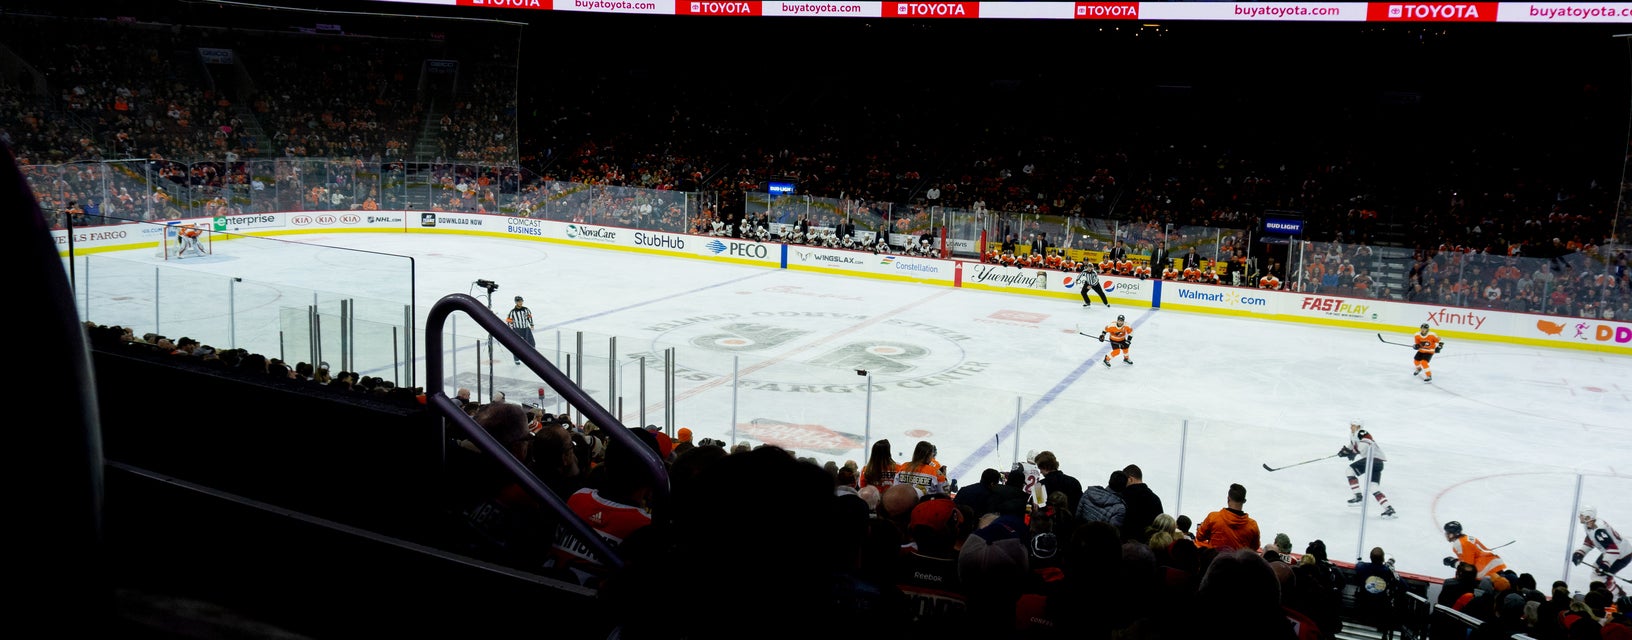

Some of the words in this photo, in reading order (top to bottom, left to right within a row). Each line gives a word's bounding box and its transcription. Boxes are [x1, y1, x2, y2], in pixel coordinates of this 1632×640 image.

[575, 0, 655, 10] buyatoyota.com
[702, 2, 750, 13] TOYOTA
[782, 2, 861, 13] buyatoyota.com
[910, 4, 965, 15] TOYOTA
[1088, 5, 1137, 15] TOYOTA
[1234, 5, 1340, 17] buyatoyota.com
[1404, 5, 1479, 18] TOYOTA
[1530, 5, 1632, 19] buyatoyota.c
[218, 214, 275, 226] enterprise
[438, 217, 469, 226] DOWNLOAD
[470, 218, 483, 226] NOW
[508, 217, 542, 227] COMCAST
[508, 225, 542, 236] BUSINESS
[579, 226, 616, 240] NovaCare
[1280, 223, 1300, 231] LIGHT
[90, 230, 127, 241] FARGO
[634, 232, 685, 250] StubHub
[729, 242, 768, 259] PECO
[895, 261, 939, 274] Constellation
[971, 264, 1037, 286] Yuengling
[1116, 282, 1140, 291] pepsi
[1178, 288, 1224, 303] Walmart
[1427, 308, 1487, 330] xfinity
[914, 571, 943, 583] Reebok
